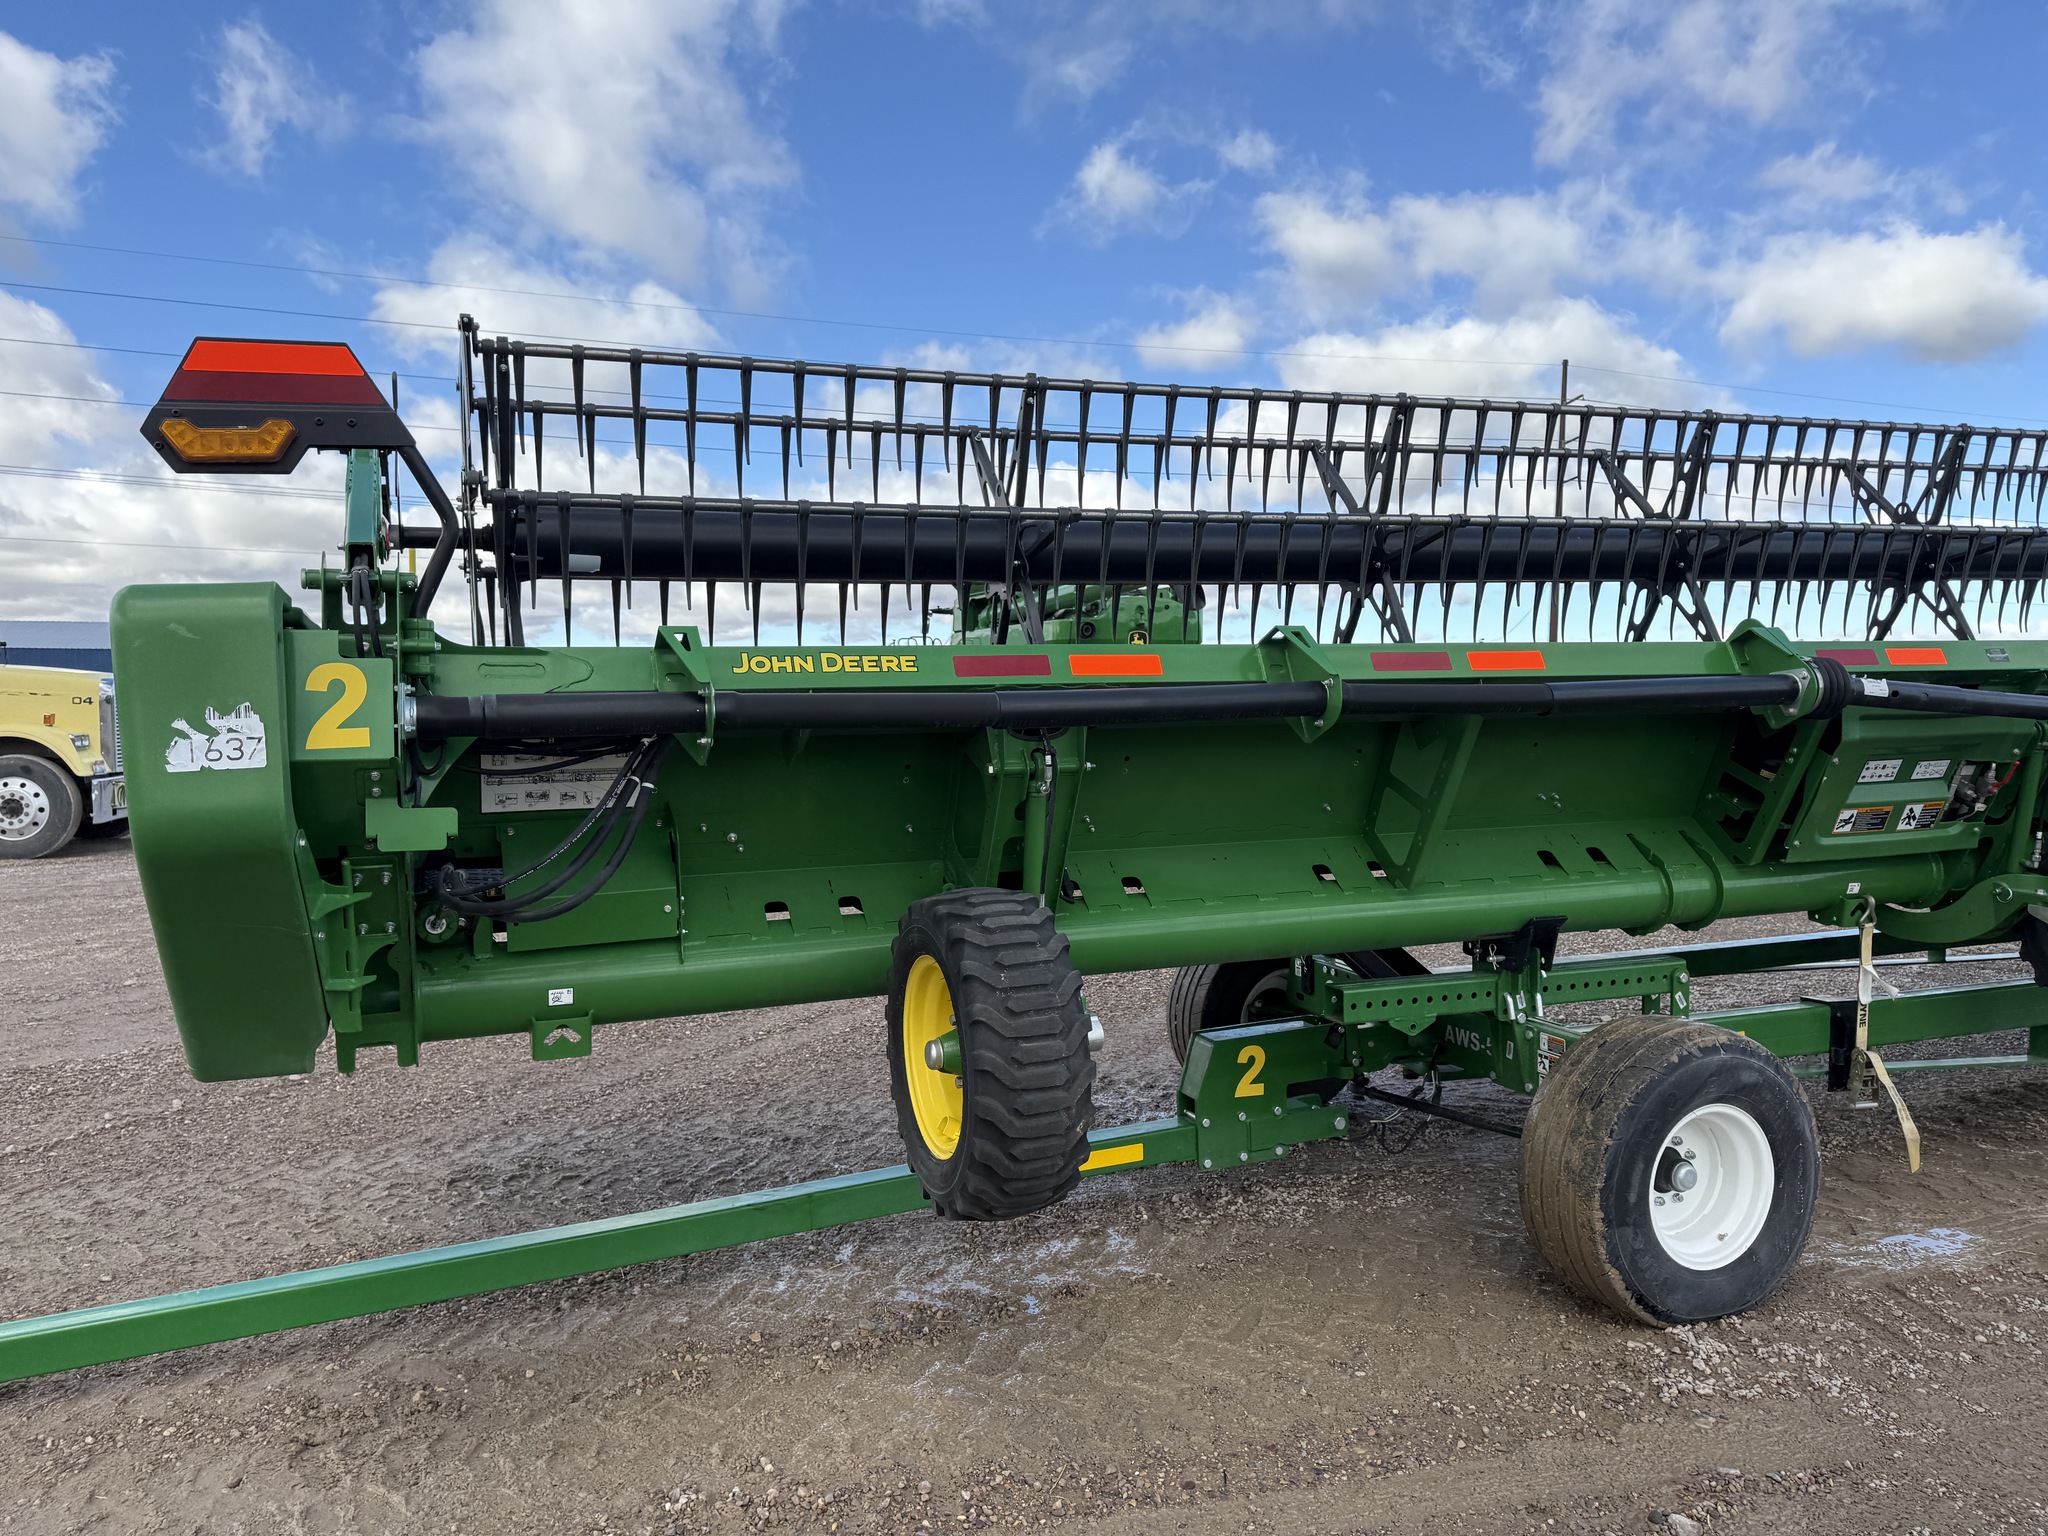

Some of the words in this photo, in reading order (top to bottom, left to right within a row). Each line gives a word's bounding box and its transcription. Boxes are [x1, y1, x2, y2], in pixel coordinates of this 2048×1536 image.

[732, 652, 815, 674] JOHN
[819, 652, 918, 673] DEERE
[305, 662, 370, 750] 2
[1234, 1045, 1266, 1098] 2
